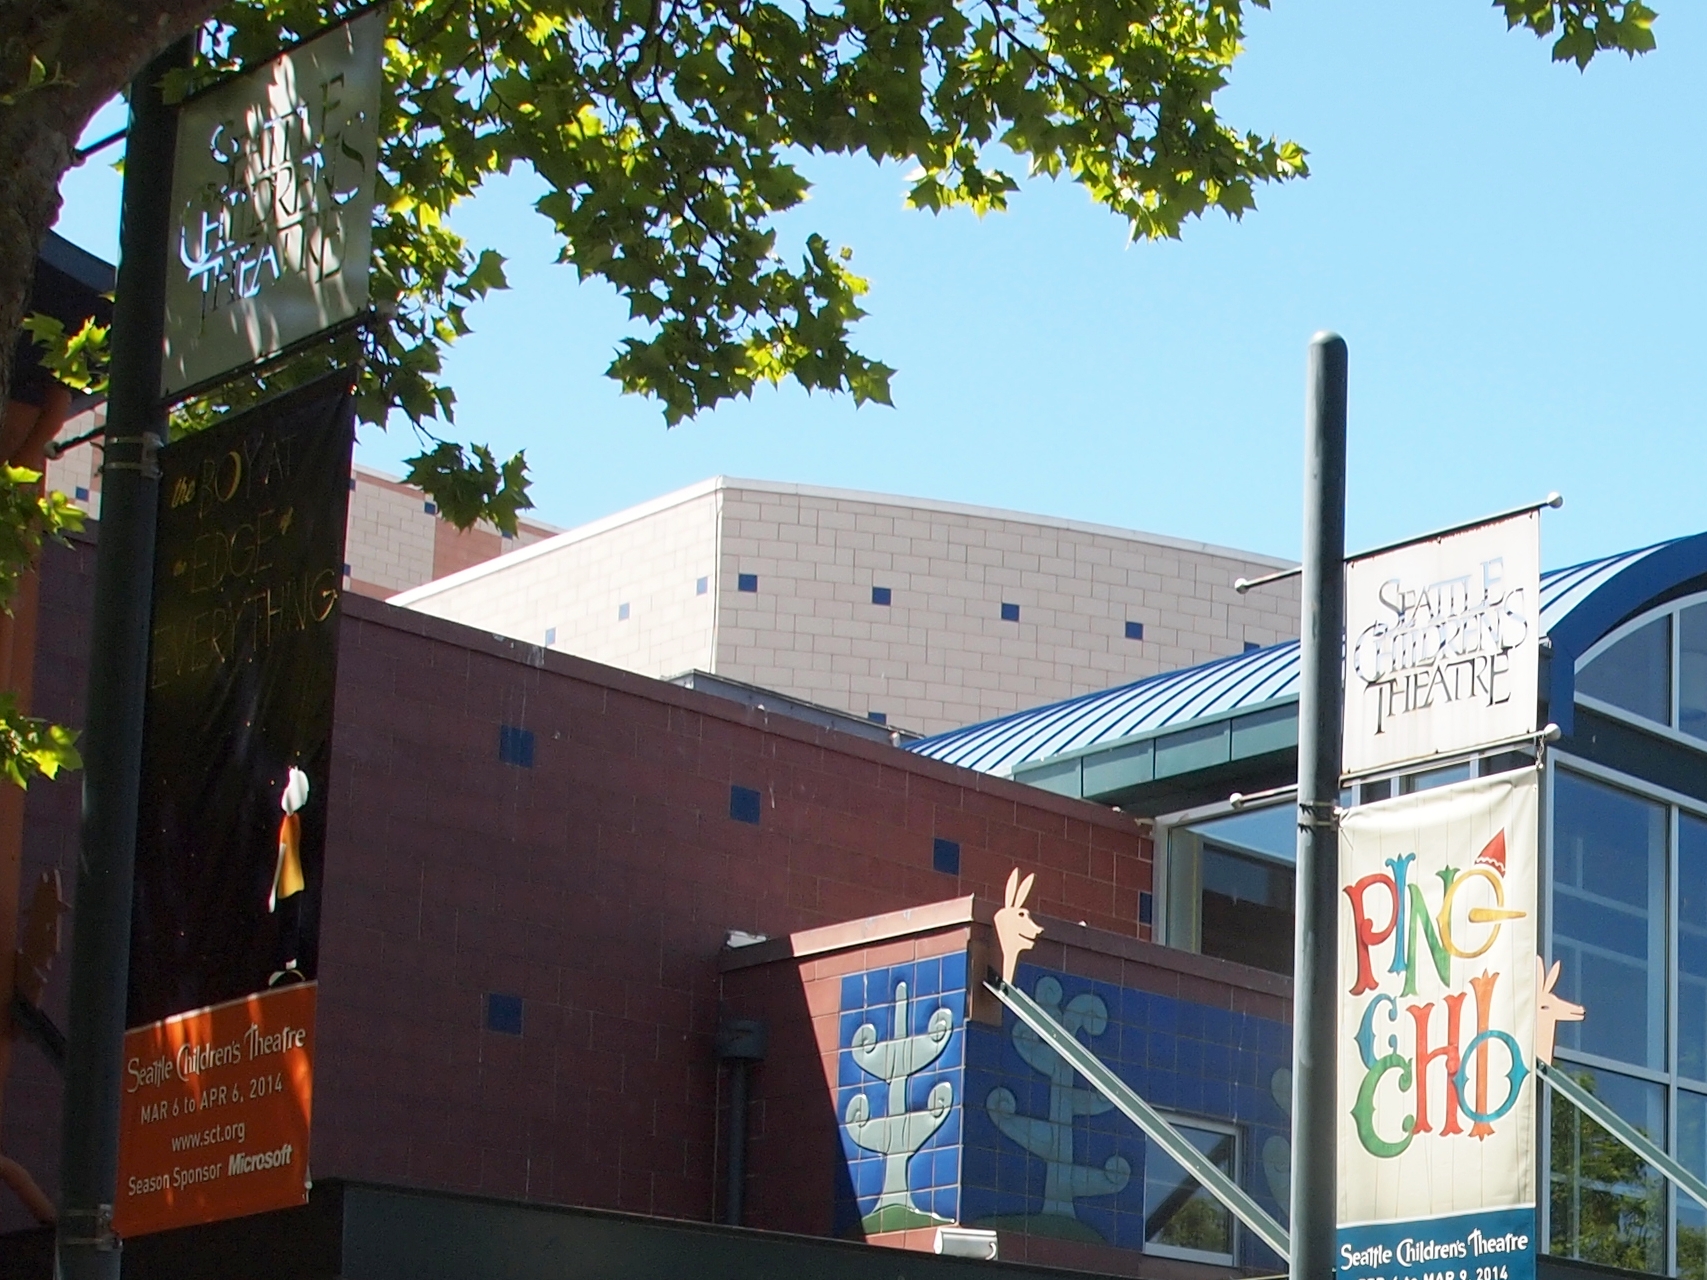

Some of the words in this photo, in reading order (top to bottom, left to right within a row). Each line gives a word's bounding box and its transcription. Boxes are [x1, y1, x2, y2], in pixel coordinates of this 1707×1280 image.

[1378, 556, 1505, 632] SEATTLE
[1364, 650, 1512, 736] THEATRE
[127, 1056, 173, 1092] Seattle
[177, 1041, 241, 1082] Children's
[244, 1022, 305, 1060] Theatre
[141, 1103, 167, 1124] MAR
[173, 1100, 178, 1116] 6
[185, 1099, 195, 1113] to
[200, 1086, 226, 1110] APR
[232, 1084, 244, 1102] 6,
[250, 1073, 282, 1098] 2014
[172, 1123, 245, 1151] www.sct.org
[129, 1175, 169, 1196] Season
[173, 1163, 222, 1190] Sponsor
[228, 1144, 292, 1176] Microsoft
[1340, 1244, 1392, 1270] Seattle
[1397, 1238, 1466, 1267] Children's
[1467, 1228, 1529, 1257] Theatre
